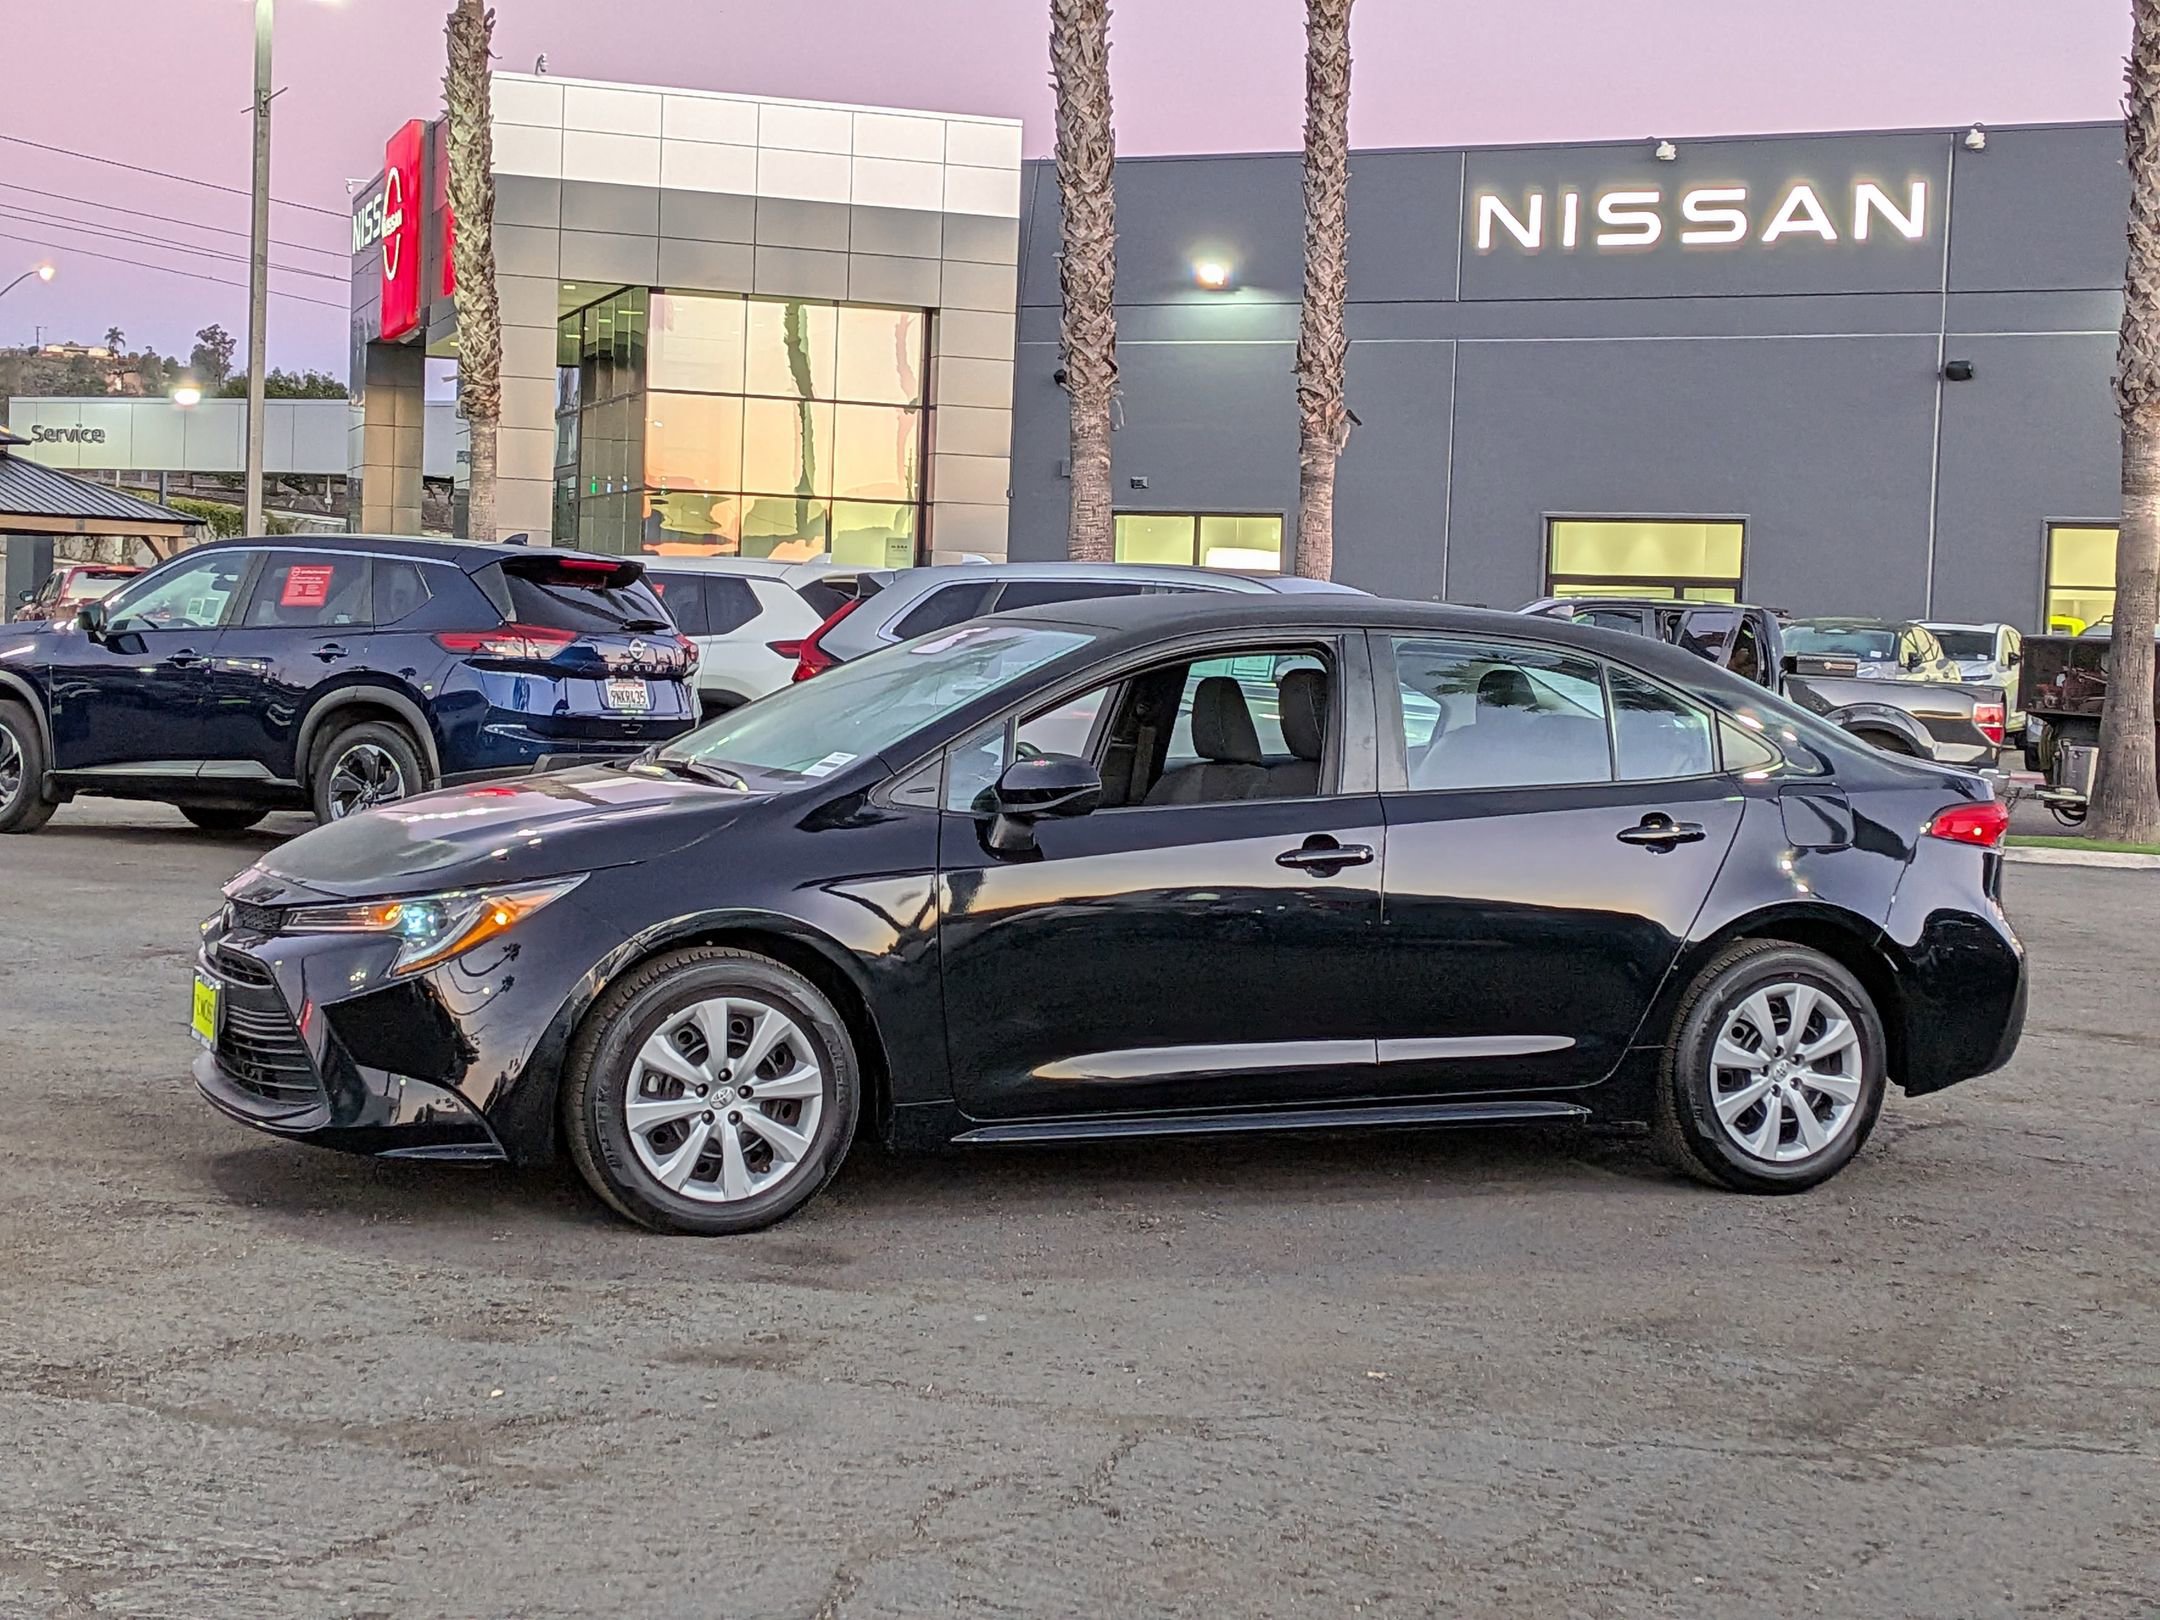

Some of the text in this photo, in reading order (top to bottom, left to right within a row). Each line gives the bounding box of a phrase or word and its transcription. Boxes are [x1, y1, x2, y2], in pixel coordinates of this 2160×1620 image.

[352, 193, 382, 254] NISS
[1477, 181, 1927, 250] NISSAN
[31, 423, 105, 443] Service
